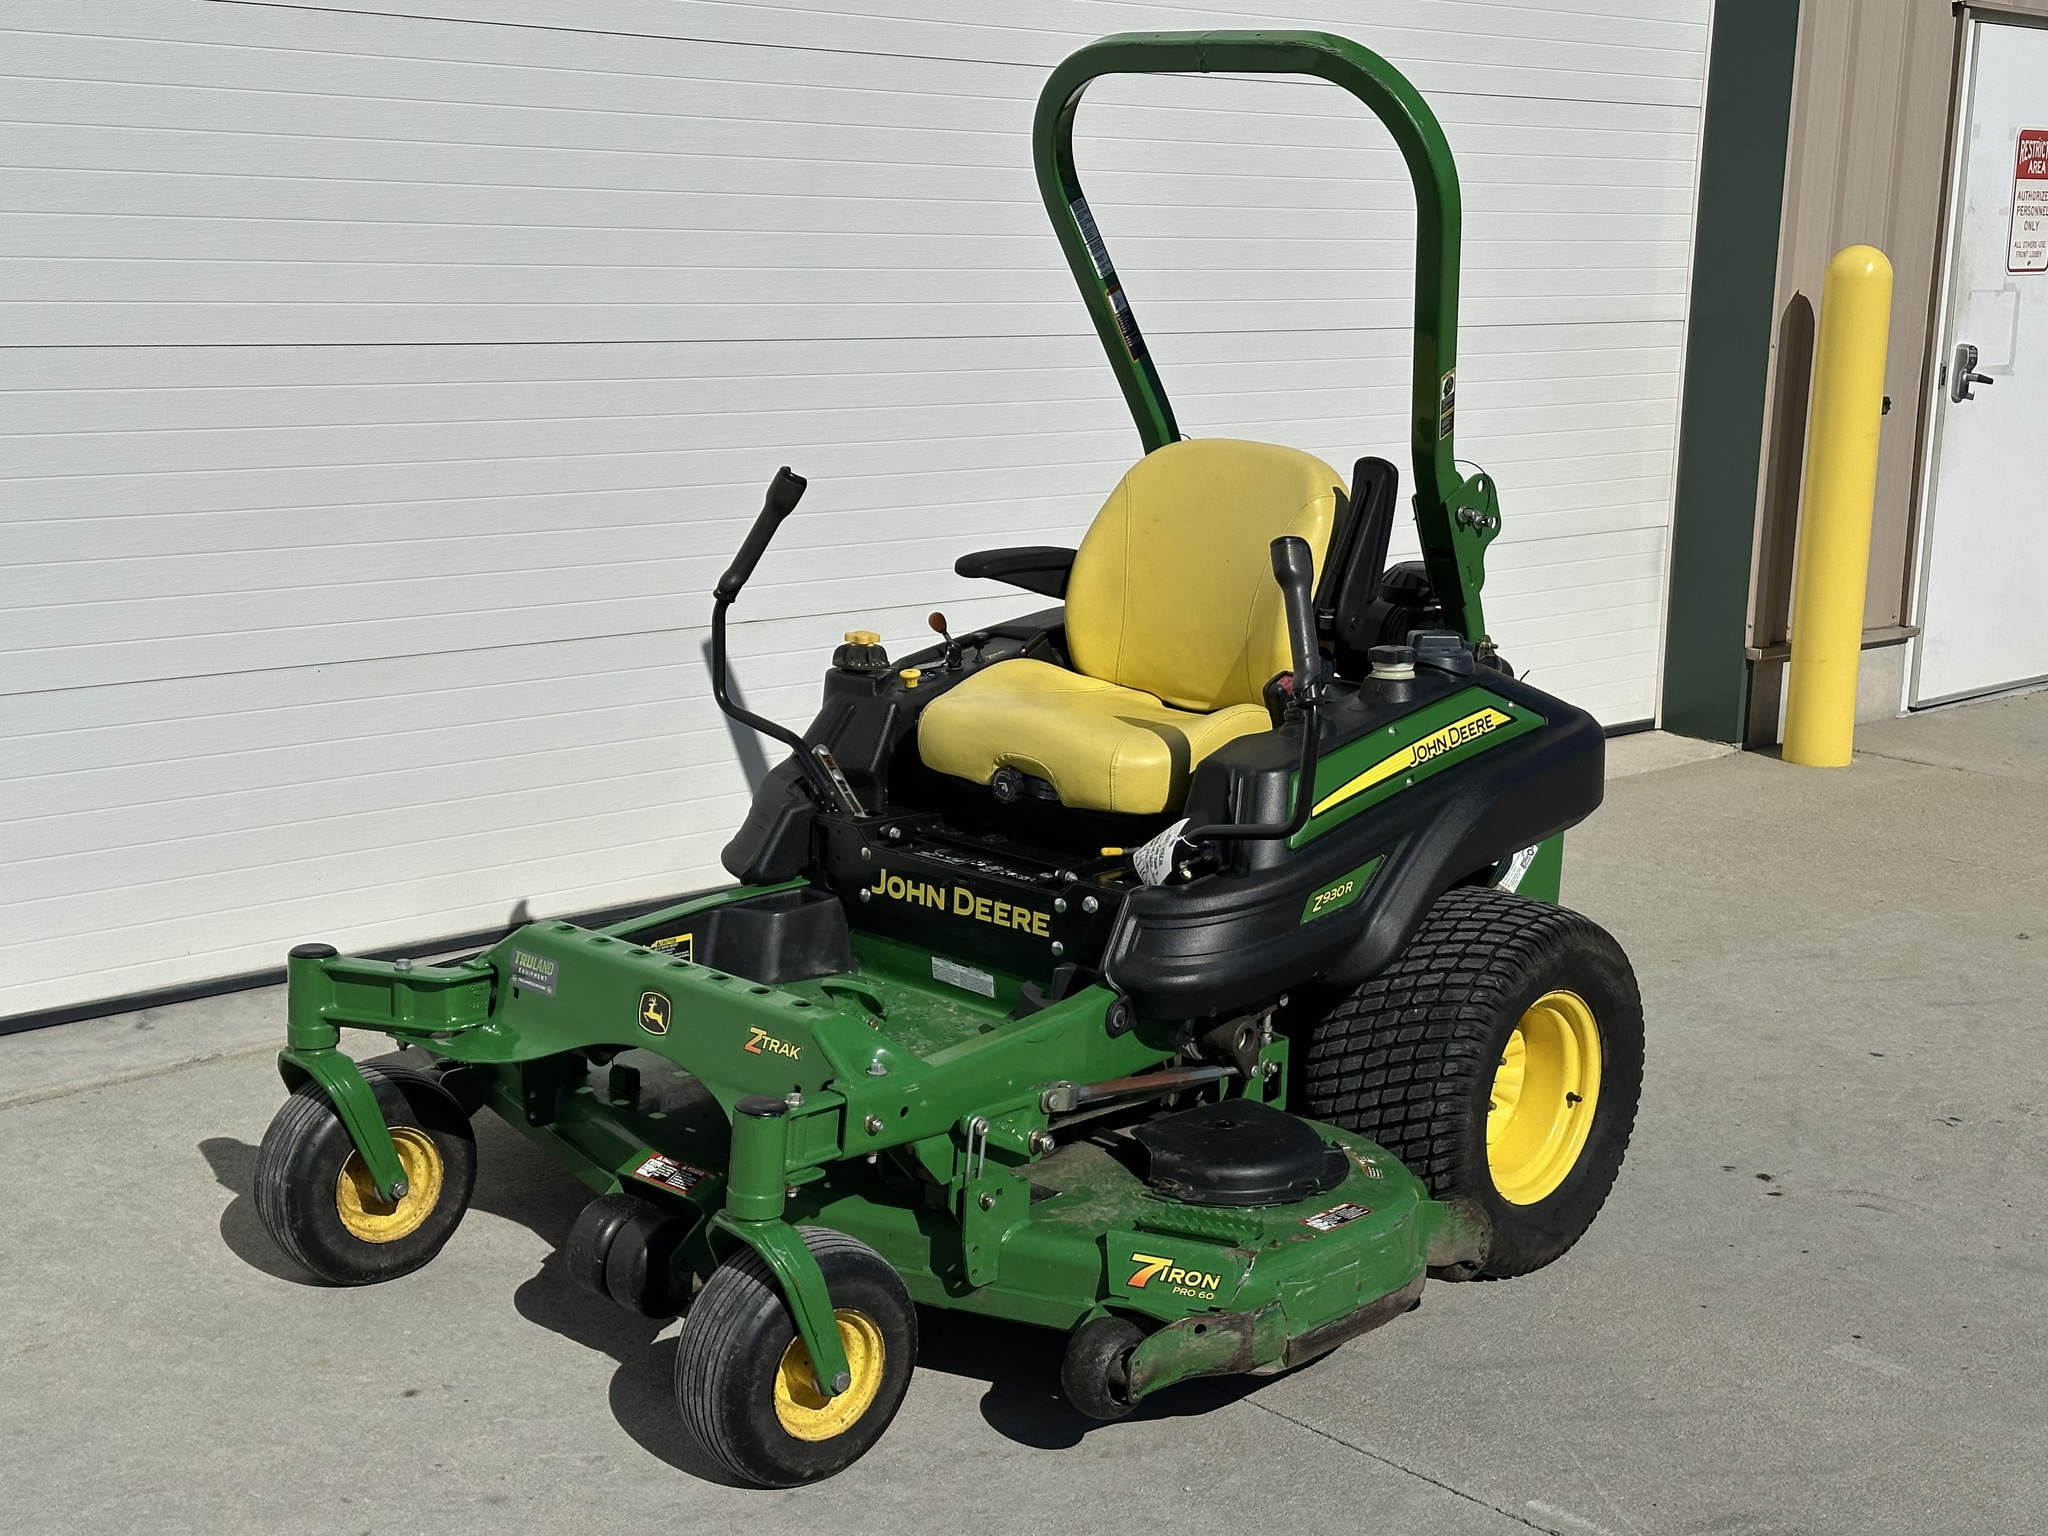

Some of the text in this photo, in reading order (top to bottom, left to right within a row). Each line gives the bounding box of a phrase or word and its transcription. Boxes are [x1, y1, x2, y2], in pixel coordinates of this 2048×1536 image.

[2027, 160, 2047, 174] AREA
[2023, 220, 2040, 231] ONLY
[2014, 240, 2046, 248] ALL OTHERS USE
[2015, 250, 2042, 258] FRONT LOBBY
[1410, 714, 1495, 766] JOHN DEERE
[871, 868, 1051, 938] JOHN DEERE
[1312, 880, 1354, 913] Z930R
[514, 950, 555, 976] TRULAND
[518, 967, 548, 982] EQUIPMENT
[1172, 1286, 1214, 1300] PRO 60
